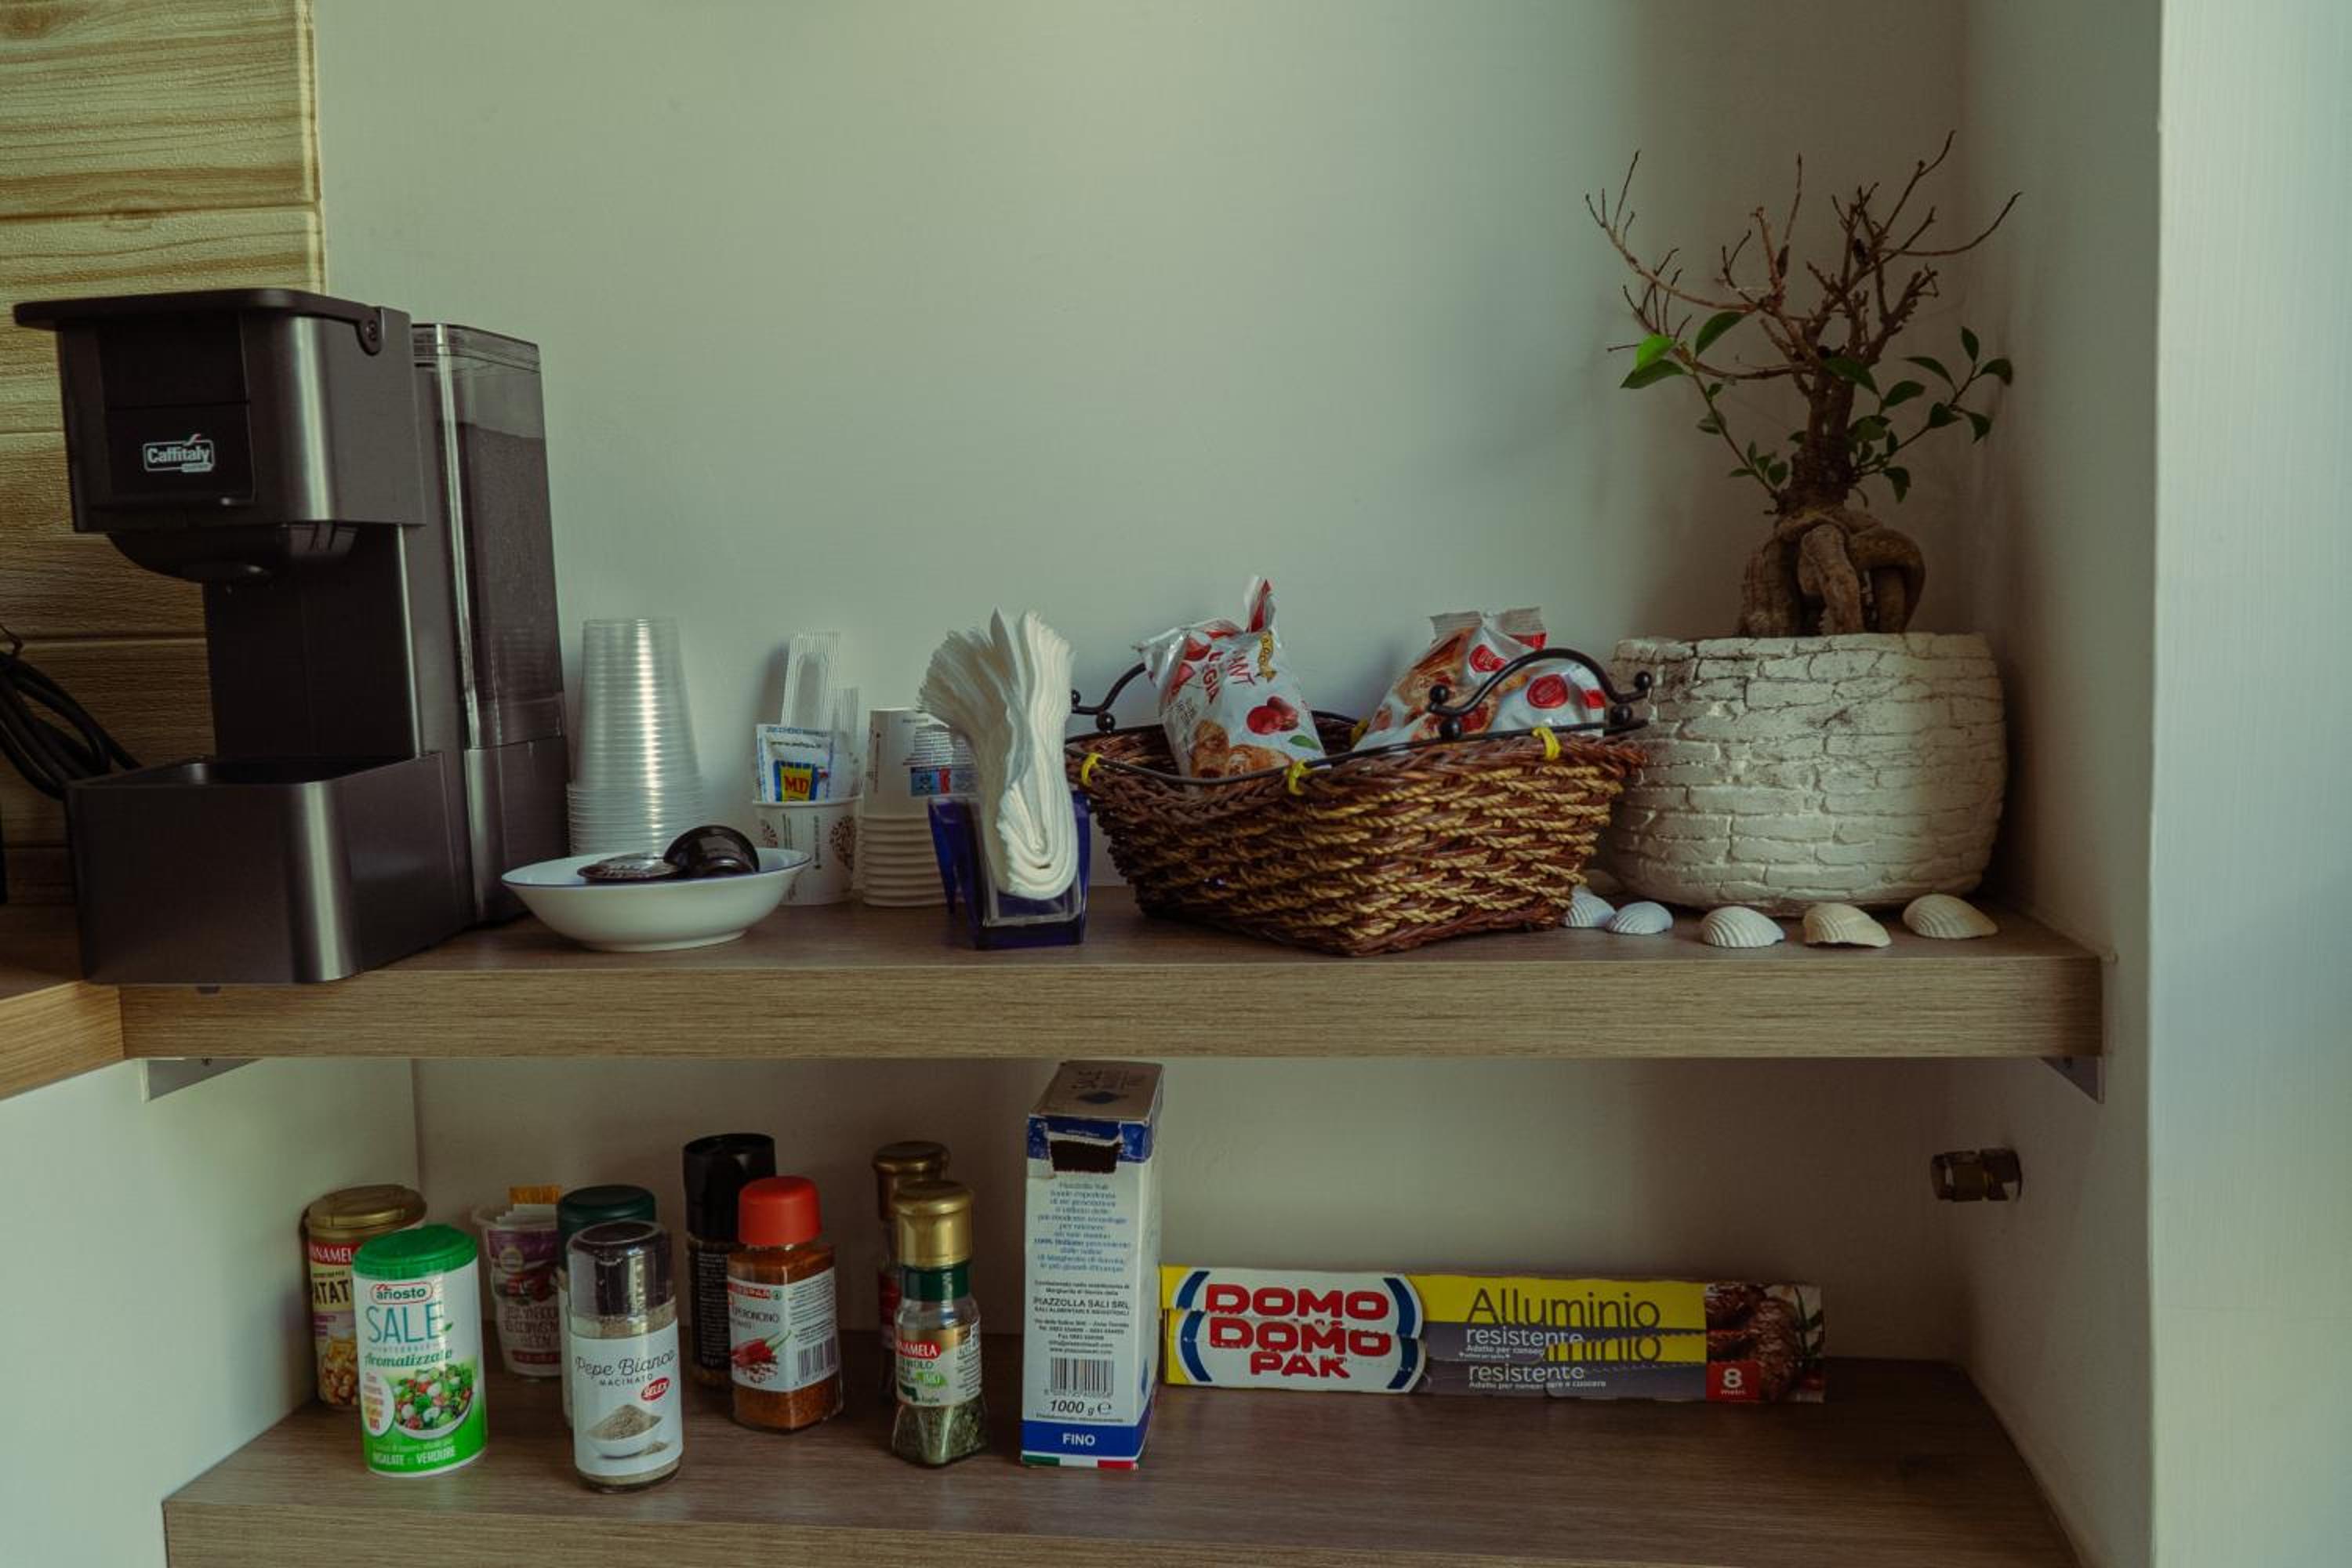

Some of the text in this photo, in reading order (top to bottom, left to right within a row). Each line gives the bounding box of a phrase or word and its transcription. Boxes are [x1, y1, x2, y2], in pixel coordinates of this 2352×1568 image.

[147, 445, 210, 465] Caffitaly
[784, 773, 810, 794] MD
[376, 1287, 426, 1300] ariosto
[1033, 1296, 1086, 1308] PIAZZOLLA
[1087, 1298, 1109, 1308] SALI
[1204, 1283, 1389, 1321] DOMO
[1467, 1287, 1662, 1330] Alluminio
[365, 1300, 445, 1343] SALE
[1209, 1316, 1392, 1357] DOMO
[1465, 1325, 1585, 1347] resistente
[364, 1348, 452, 1368] Aromatizzato
[575, 1356, 615, 1380] Pepe
[1249, 1350, 1352, 1379] PAK
[599, 1373, 653, 1387] MACINATO
[1468, 1363, 1585, 1383] resistente
[1722, 1367, 1744, 1389] 8
[1049, 1399, 1094, 1416] 1000 g
[1062, 1432, 1096, 1446] FINO
